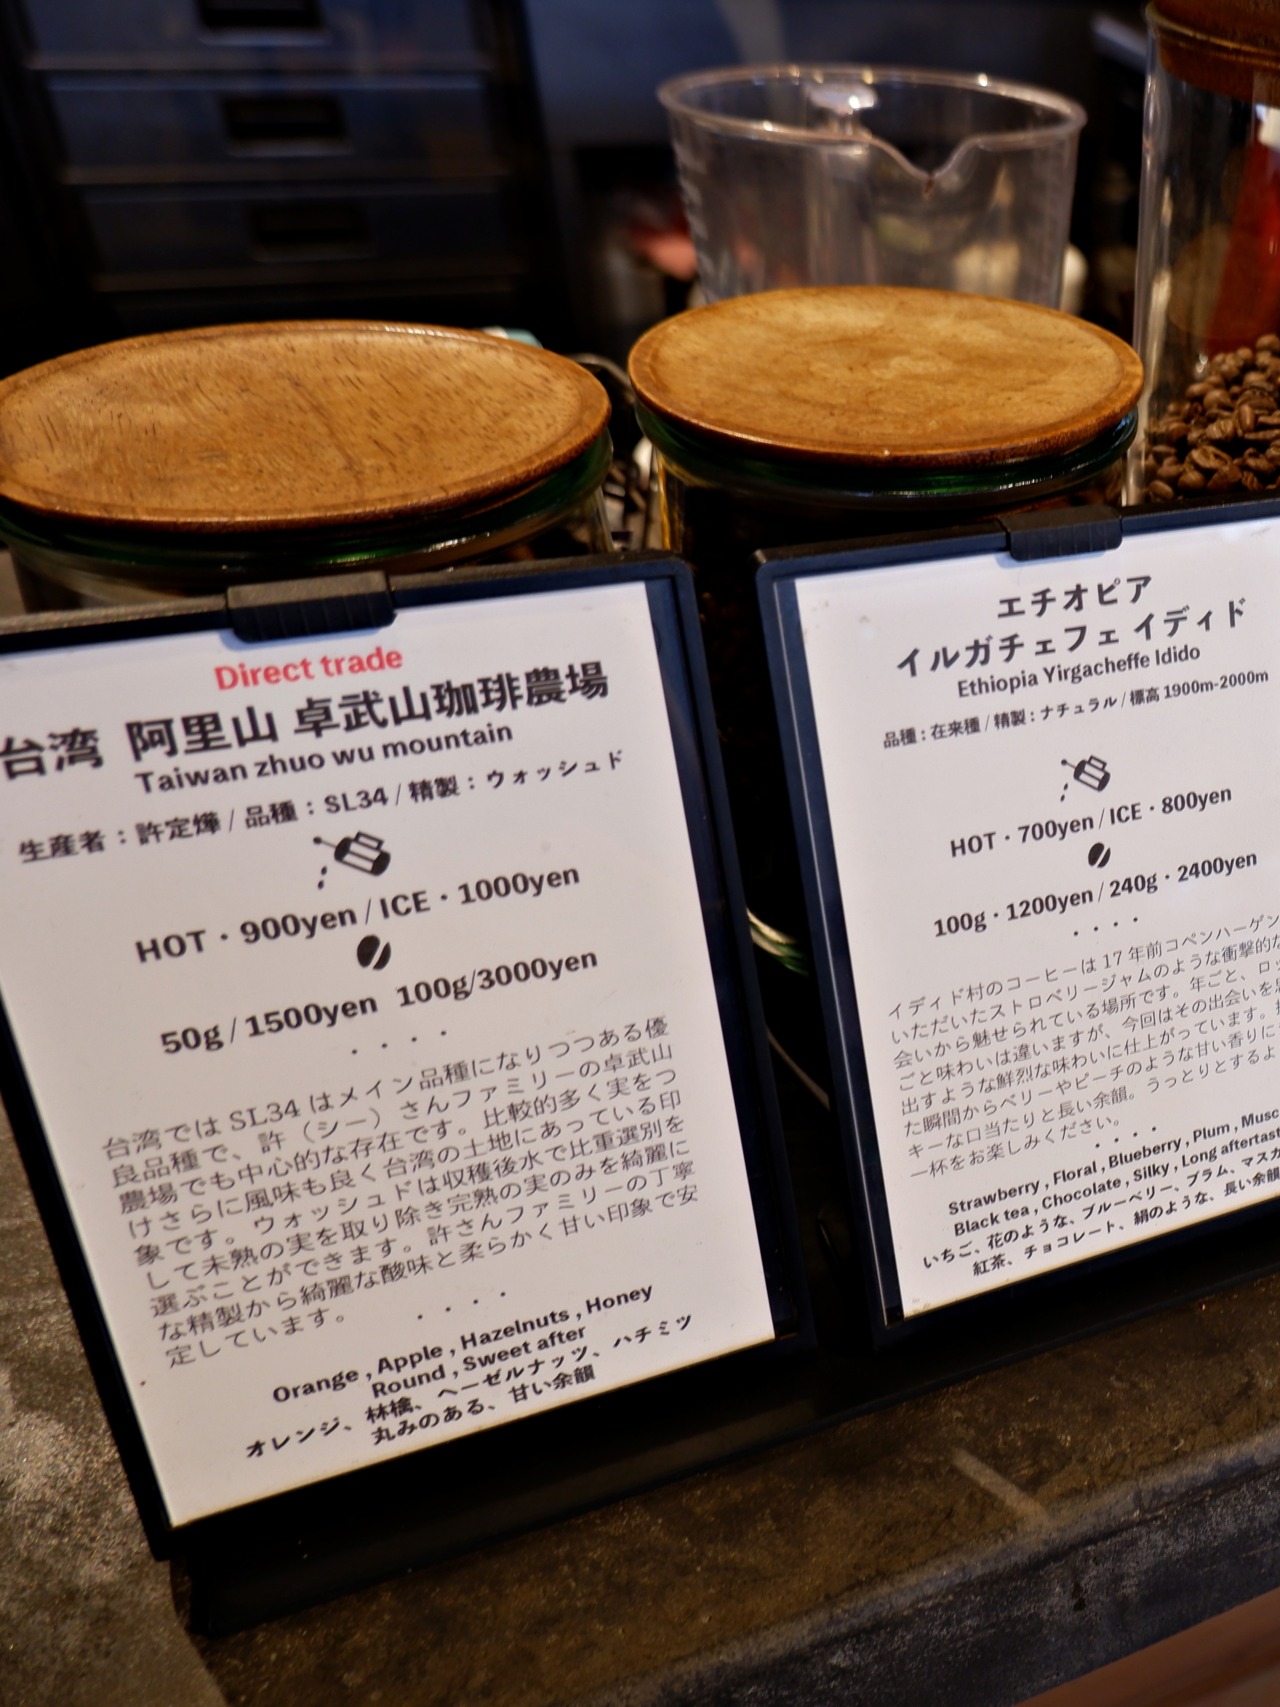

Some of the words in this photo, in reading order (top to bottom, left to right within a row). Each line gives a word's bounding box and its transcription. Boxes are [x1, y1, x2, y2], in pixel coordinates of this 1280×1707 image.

[997, 575, 1151, 618] エチオピア
[214, 658, 314, 690] Direct
[320, 646, 402, 676] trade
[897, 625, 1119, 677] イルガチェフェ
[1134, 597, 1245, 640] イディド
[957, 670, 1038, 697] Ethiopia
[1043, 652, 1150, 684] Yirgacheffe
[1155, 644, 1200, 665] Idido
[0, 727, 104, 780] 台湾
[125, 706, 278, 762] 阿里山
[294, 661, 608, 738] 卓武山珈琲農場
[883, 716, 980, 748] 品種：在来種
[993, 696, 1117, 729] 精製：ナチュラル
[1129, 687, 1159, 706] 標高
[1163, 671, 1268, 699] 1900m-2000m
[134, 764, 248, 793] Taiwan
[254, 753, 325, 777] zhuo
[331, 746, 374, 765] wu
[382, 722, 512, 758] mountain
[245, 787, 388, 828] 品種：SL34
[408, 750, 621, 802] 精製：ウォッシュド
[161, 1025, 224, 1054] 50g
[245, 997, 377, 1037] 1500yen
[397, 952, 597, 1006] 100g/3000yen
[889, 957, 1096, 1019] イディド村のコーヒーは
[1103, 950, 1122, 969] 17
[103, 1116, 221, 1160] 台湾では
[229, 1099, 300, 1130] SL34
[948, 1180, 1039, 1215] Strawberry
[1053, 1160, 1097, 1185] Floral
[1108, 1138, 1181, 1168] Blueberry
[1193, 1124, 1230, 1142] Plum
[954, 1212, 999, 1236] Black
[1003, 1206, 1029, 1221] tea
[1042, 1178, 1121, 1209] Chocolate
[1133, 1163, 1169, 1181] Silky
[1181, 1146, 1217, 1167] Long
[165, 1308, 344, 1368] 定しています。
[371, 1364, 445, 1398] Round
[463, 1341, 531, 1371] Sweet
[537, 1326, 585, 1350] after
[378, 1345, 442, 1374] Apple
[460, 1310, 569, 1350] Hazelnuts
[586, 1285, 652, 1314] Honey
[371, 1364, 595, 1445] 丸みのある、甘い余韻
